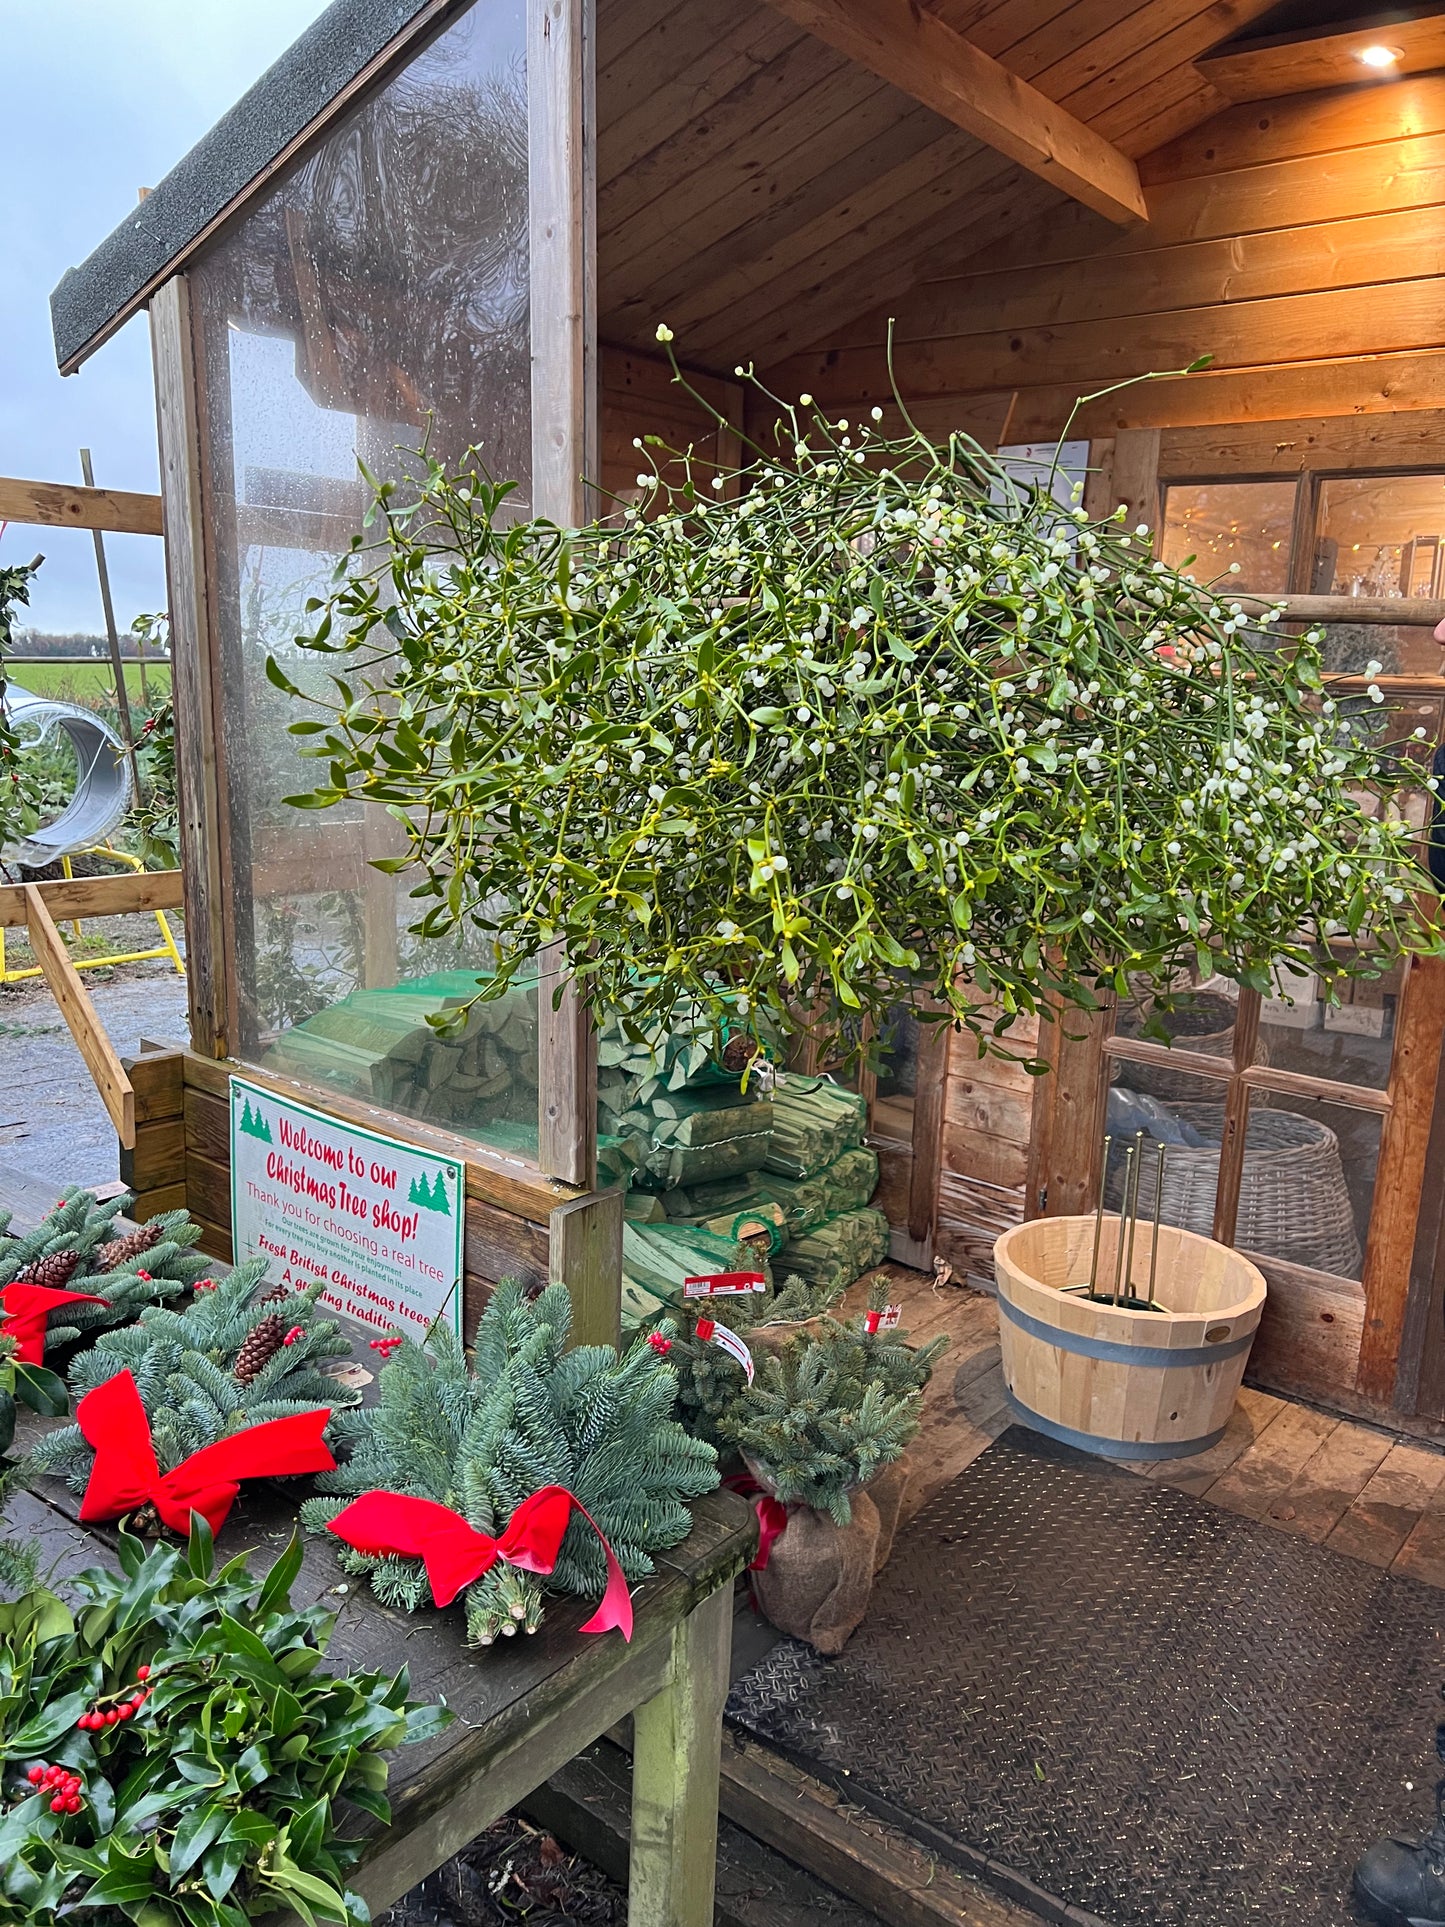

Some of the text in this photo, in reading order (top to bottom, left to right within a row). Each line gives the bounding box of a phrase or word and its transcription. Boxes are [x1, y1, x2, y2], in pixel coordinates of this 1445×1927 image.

[280, 1118, 397, 1190] Welcome to our
[247, 1182, 444, 1283] Thank you for choosing a real tree
[267, 1152, 418, 1243] Christmas Tree shop!
[259, 1234, 430, 1328] Fresh British Christmas trees
[265, 1219, 423, 1298] For every tree you buy another is planted in its place
[282, 1216, 402, 1277] Our trees are grown for your enjoyment
[282, 1269, 401, 1331] A gring traditio
